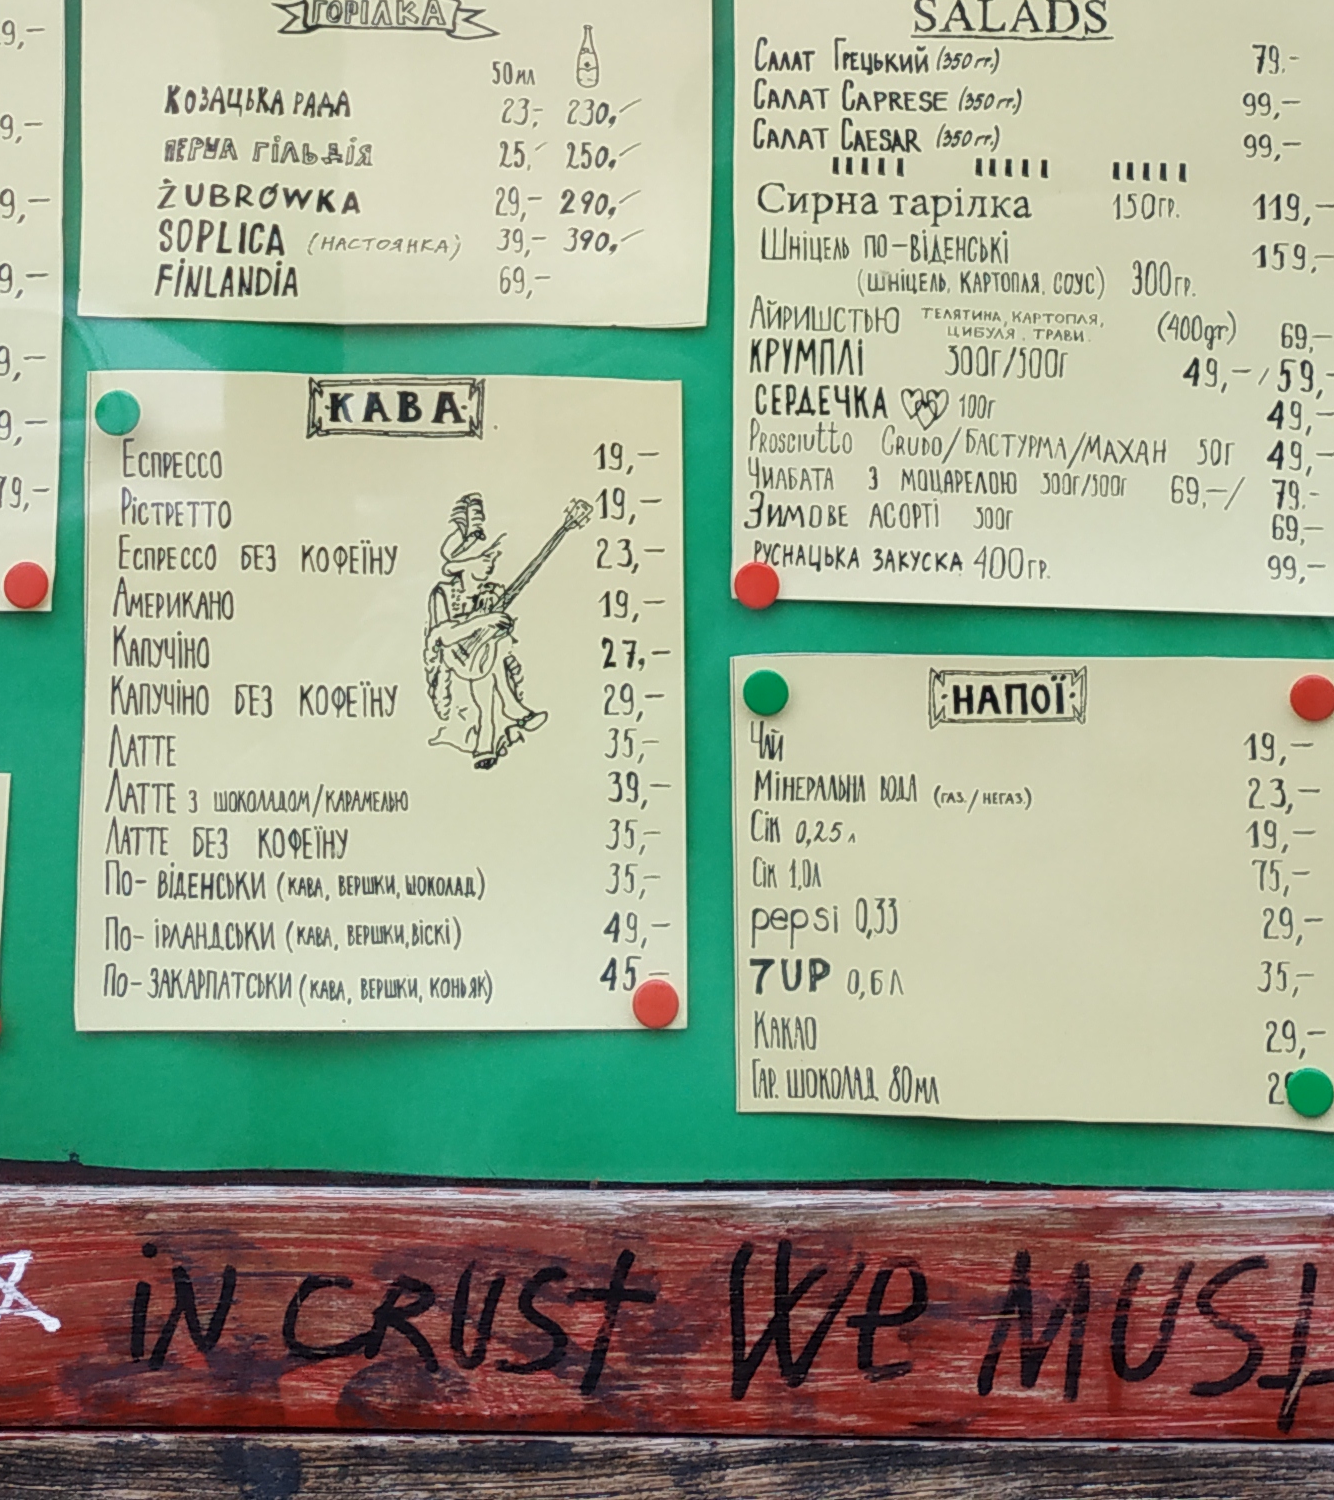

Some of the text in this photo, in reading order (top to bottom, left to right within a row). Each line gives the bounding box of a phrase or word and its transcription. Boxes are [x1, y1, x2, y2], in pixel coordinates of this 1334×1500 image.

[293, 91, 350, 118] РАДА
[757, 183, 1032, 227] Сирна тарілка
[159, 219, 285, 256] SOPLICA
[325, 391, 467, 424] КАВА
[241, 544, 276, 572] БЕЗ
[751, 906, 838, 950] pepsi
[750, 958, 830, 995] 7UP
